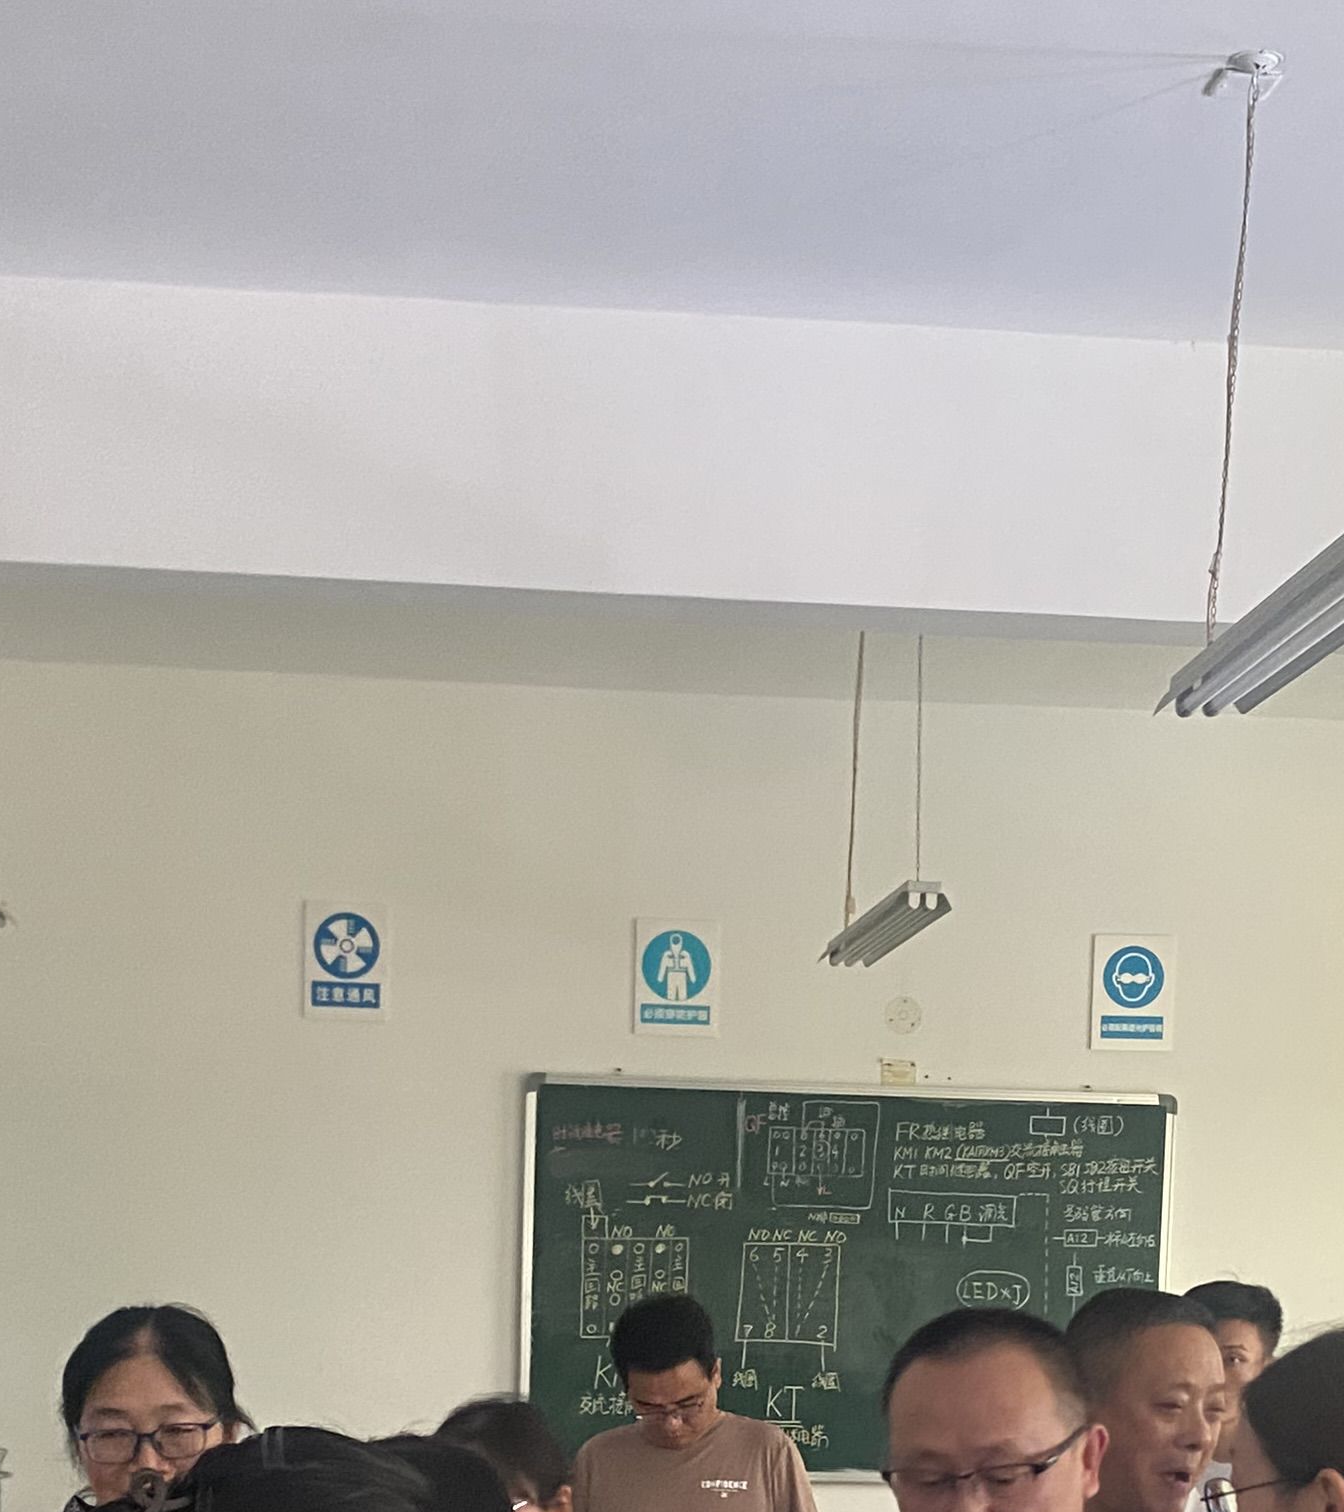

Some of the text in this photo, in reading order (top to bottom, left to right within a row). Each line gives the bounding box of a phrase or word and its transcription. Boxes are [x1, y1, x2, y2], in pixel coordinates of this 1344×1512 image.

[687, 1172, 713, 1190] NO
[687, 1193, 712, 1210] NC
[923, 1203, 936, 1221] R
[959, 1204, 972, 1222] B
[772, 1229, 793, 1242] NC
[797, 1229, 818, 1243] NC
[772, 1246, 786, 1264] 5
[796, 1247, 809, 1264] 4
[764, 1321, 777, 1339] 8
[816, 1324, 829, 1339] 2
[766, 1386, 806, 1421] KT
